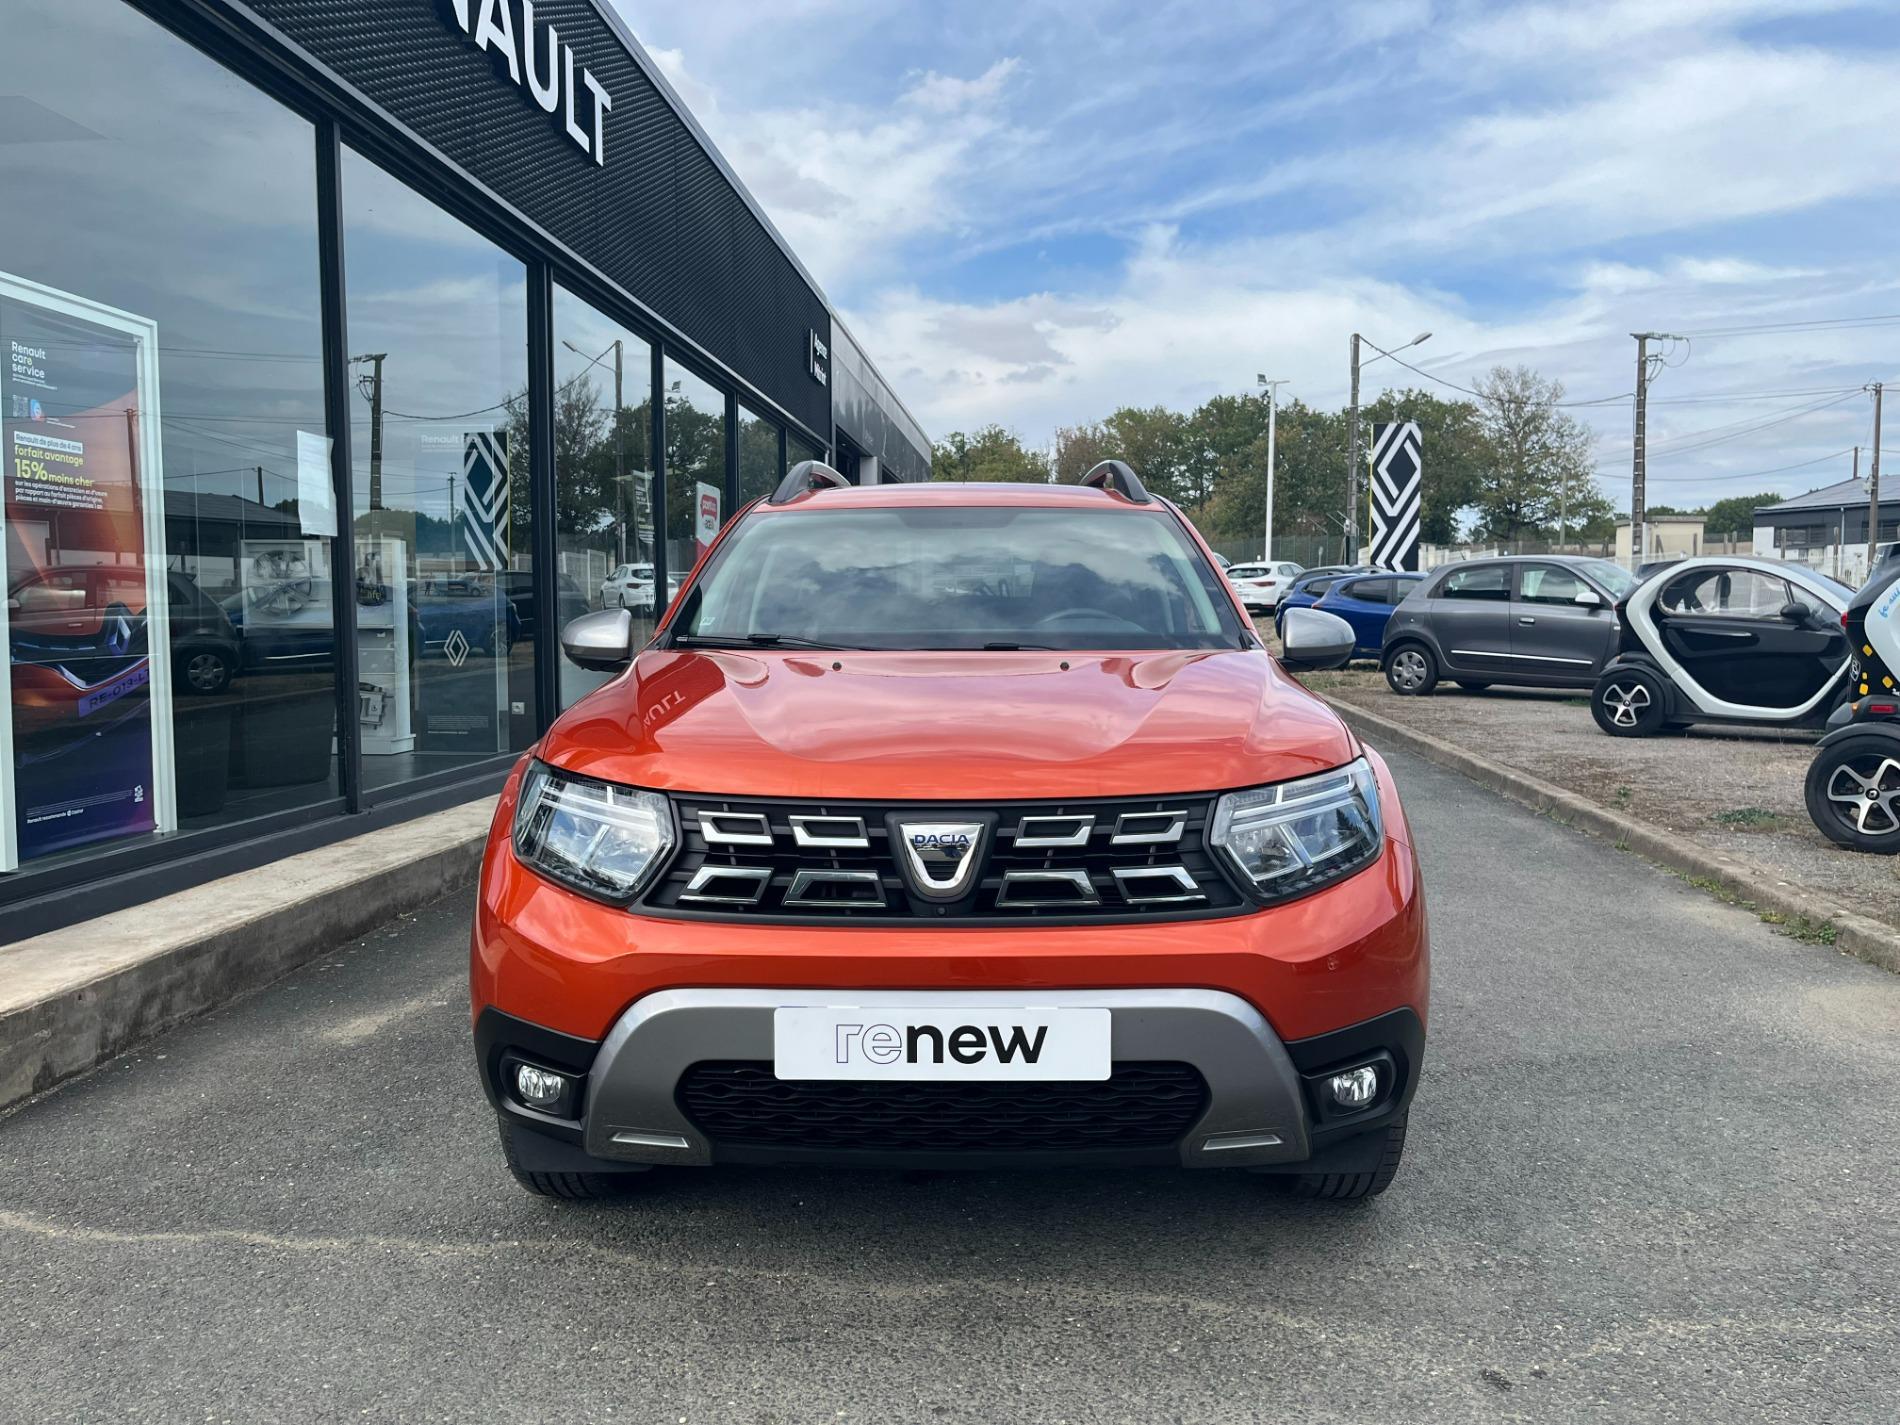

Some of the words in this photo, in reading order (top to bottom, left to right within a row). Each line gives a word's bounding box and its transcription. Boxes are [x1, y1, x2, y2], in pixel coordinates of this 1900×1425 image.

[453, 0, 612, 167] AULT
[12, 341, 46, 360] Renault
[12, 353, 32, 366] care
[12, 363, 45, 378] service
[15, 444, 43, 459] forfait
[45, 452, 84, 467] avantage
[15, 458, 47, 480] 15%
[49, 473, 73, 486] moins
[75, 476, 93, 488] cher
[914, 834, 970, 844] DACIA
[836, 1024, 1048, 1065] renew
